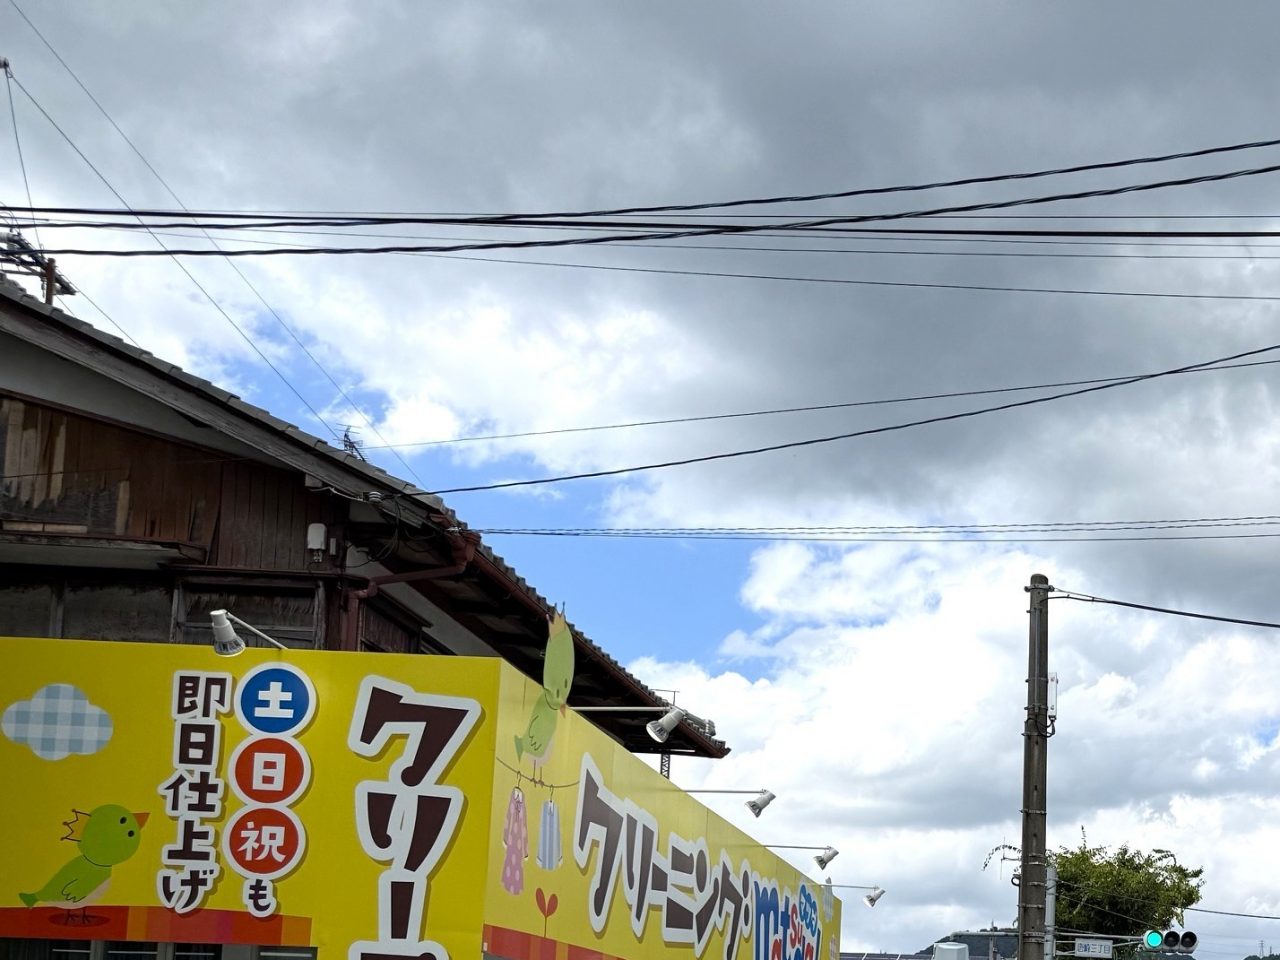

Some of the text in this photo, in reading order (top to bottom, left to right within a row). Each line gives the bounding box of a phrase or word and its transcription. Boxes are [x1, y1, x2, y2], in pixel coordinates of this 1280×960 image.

[162, 675, 227, 909] 即日仕上げ
[238, 681, 295, 912] 土日祝も
